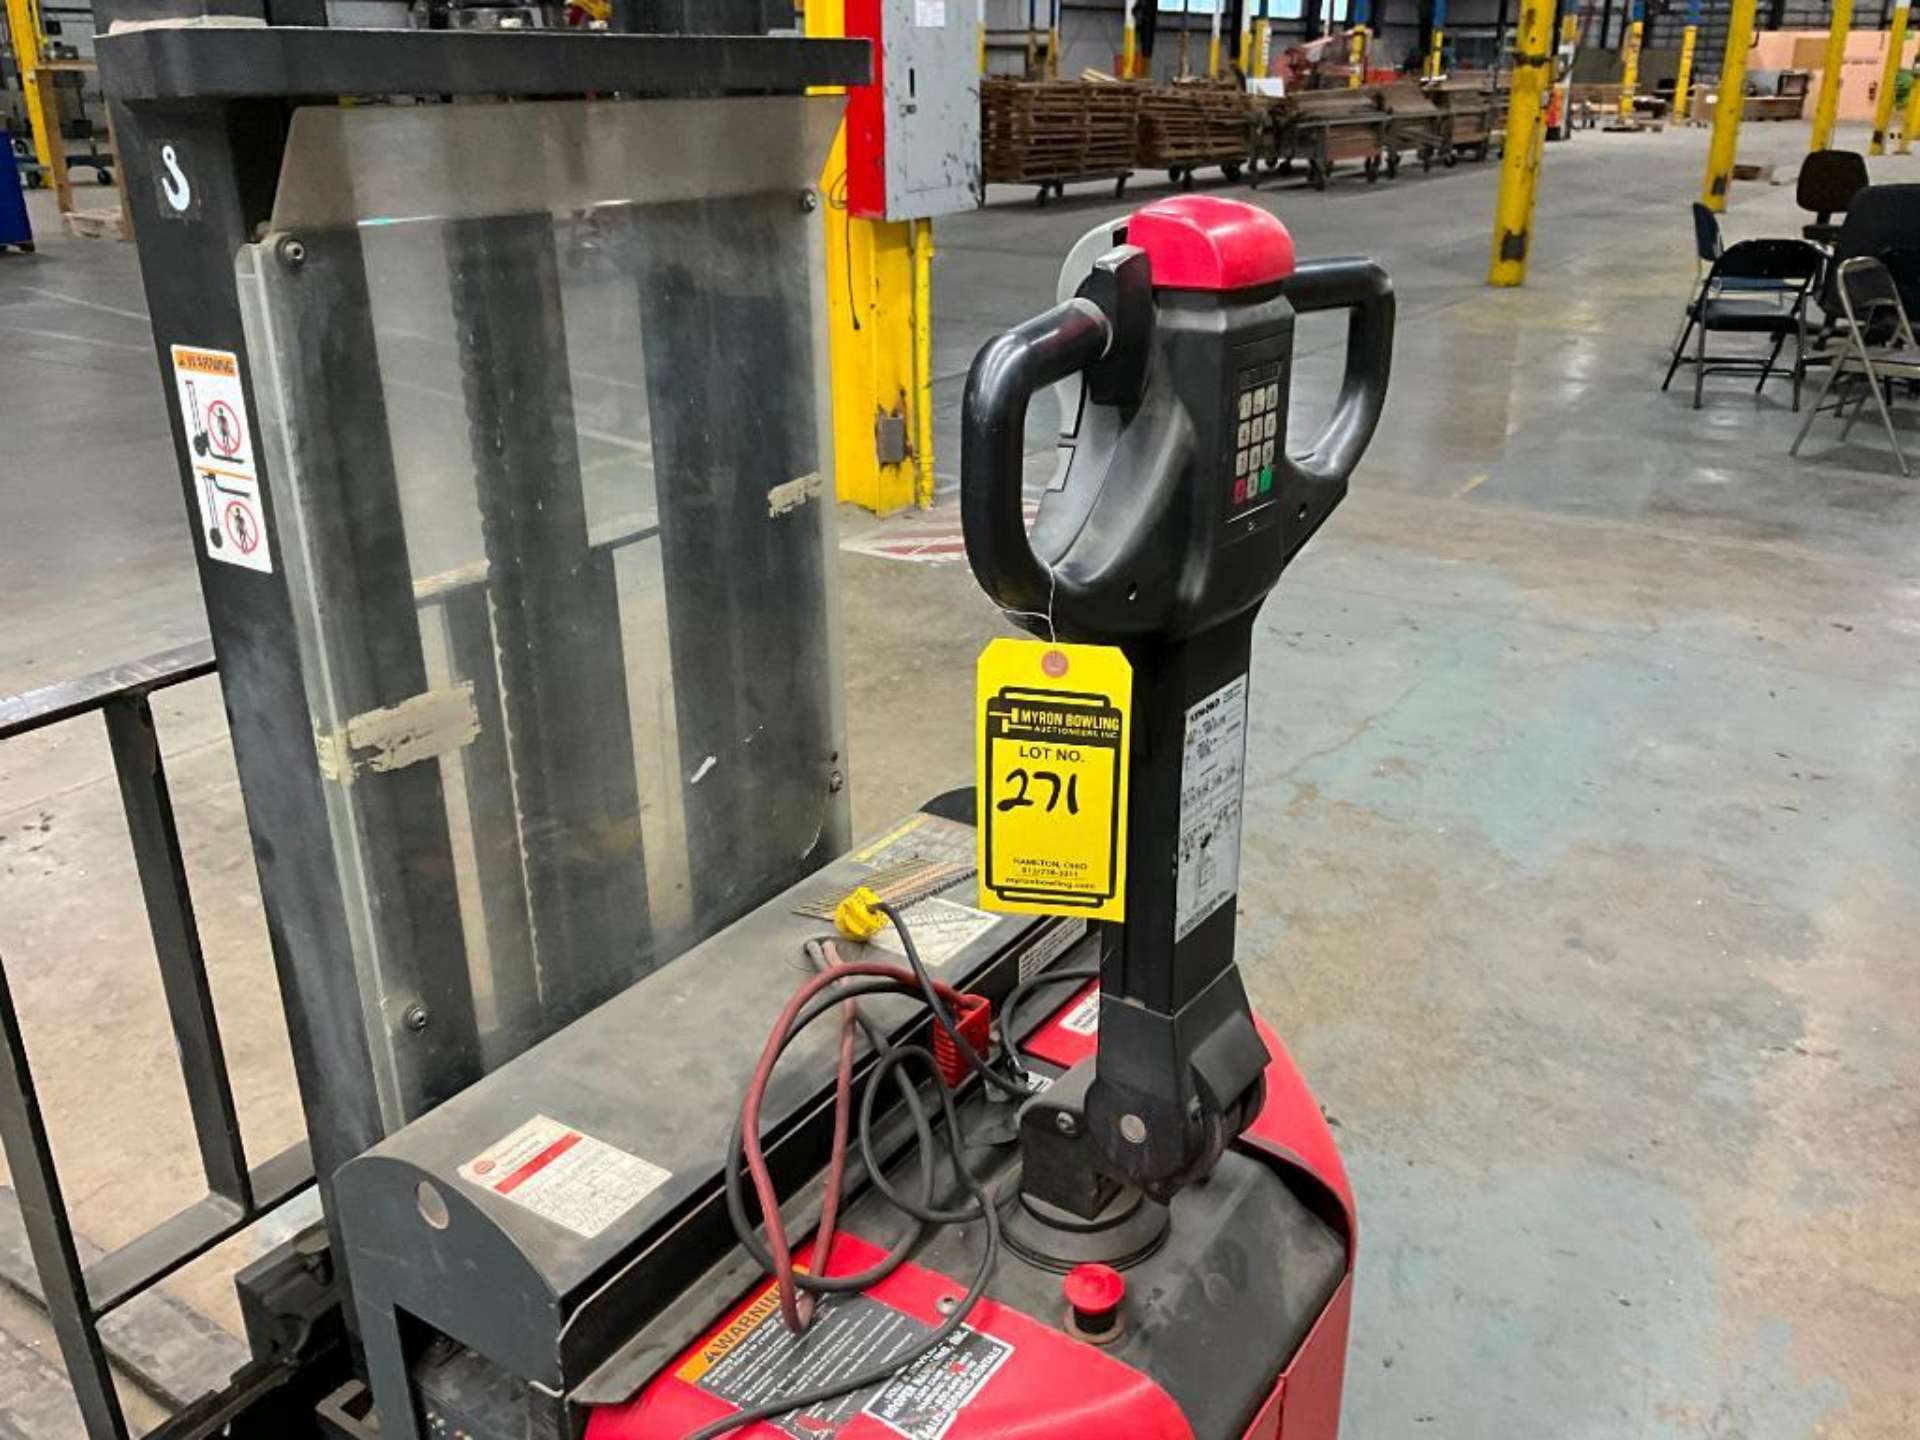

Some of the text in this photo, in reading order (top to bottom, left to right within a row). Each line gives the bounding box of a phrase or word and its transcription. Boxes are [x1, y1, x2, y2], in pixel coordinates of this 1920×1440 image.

[1021, 709, 1120, 731] MYRON BOWLING
[1019, 745, 1085, 763] LOT NO.
[996, 767, 1081, 816] 271
